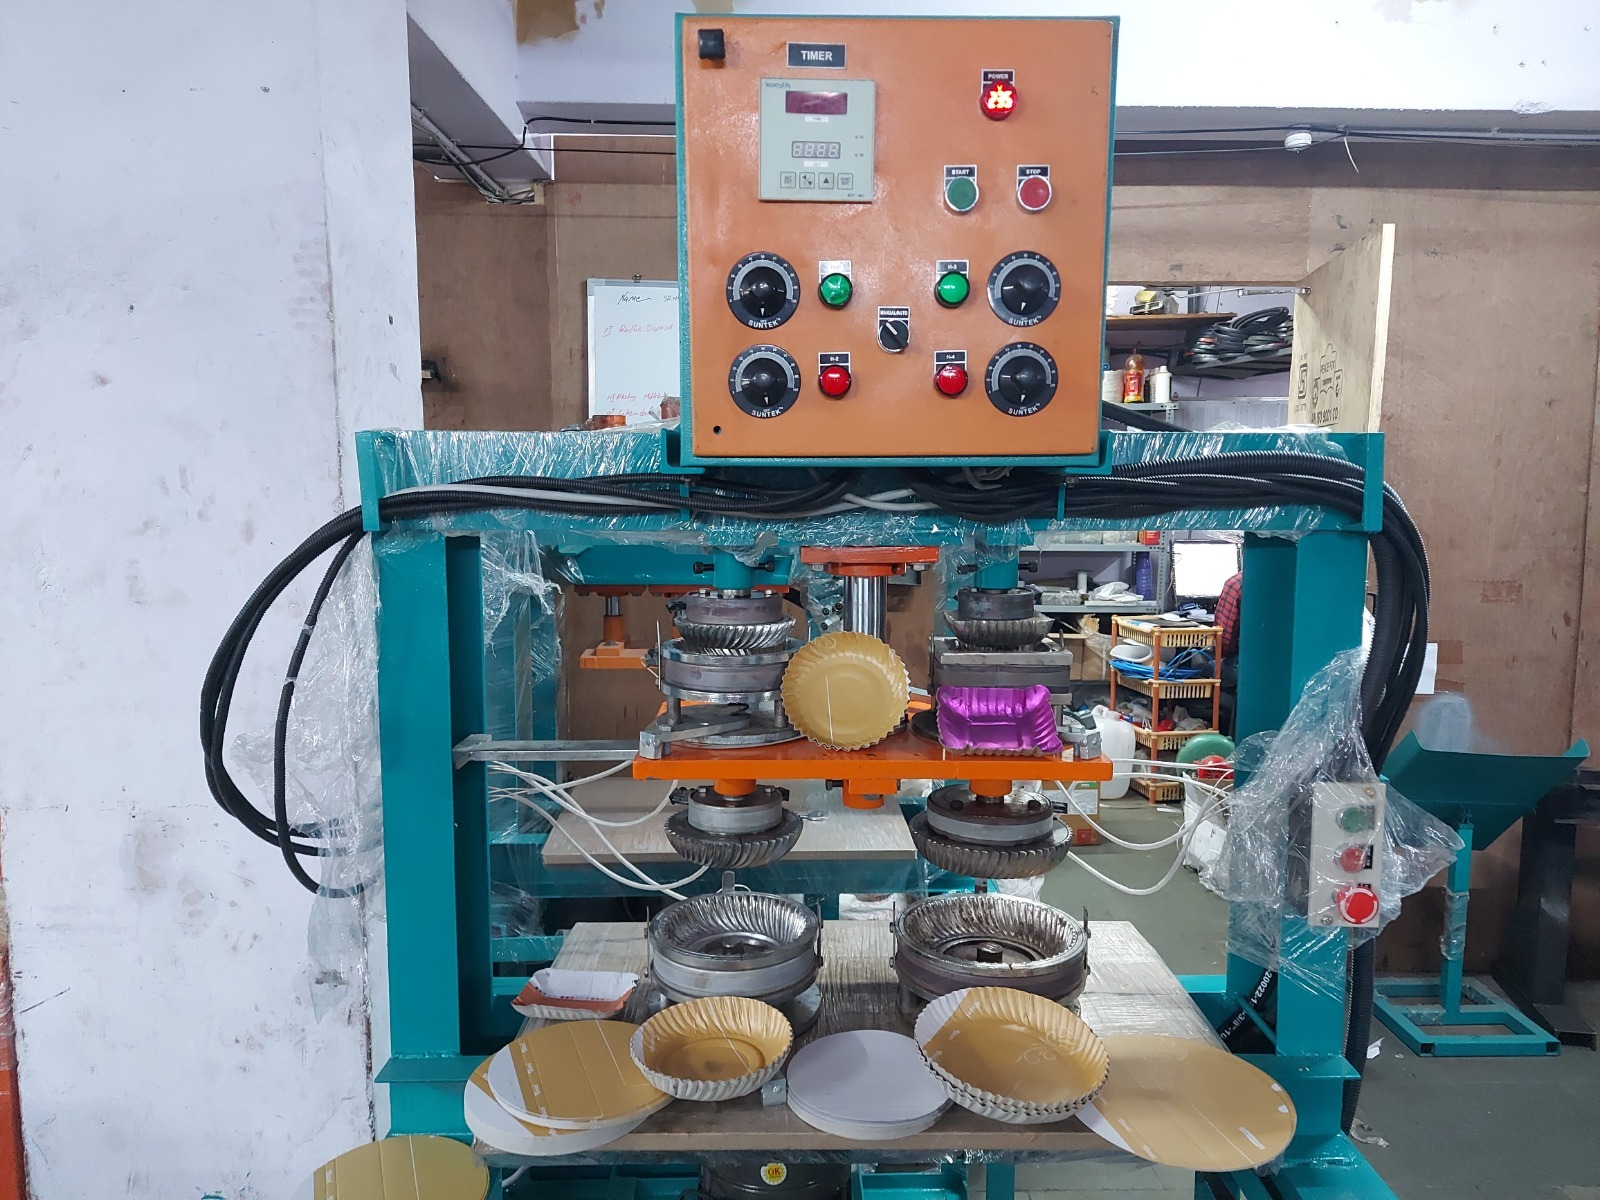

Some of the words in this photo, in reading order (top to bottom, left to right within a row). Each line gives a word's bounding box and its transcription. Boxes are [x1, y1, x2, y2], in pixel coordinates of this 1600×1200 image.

[800, 50, 833, 61] TIMER
[748, 319, 779, 329] SUNTEK
[1008, 317, 1039, 326] SUNTEK
[751, 408, 781, 418] SUNTEK
[1007, 405, 1039, 416] SUNTEK
[767, 1167, 781, 1176] OK
